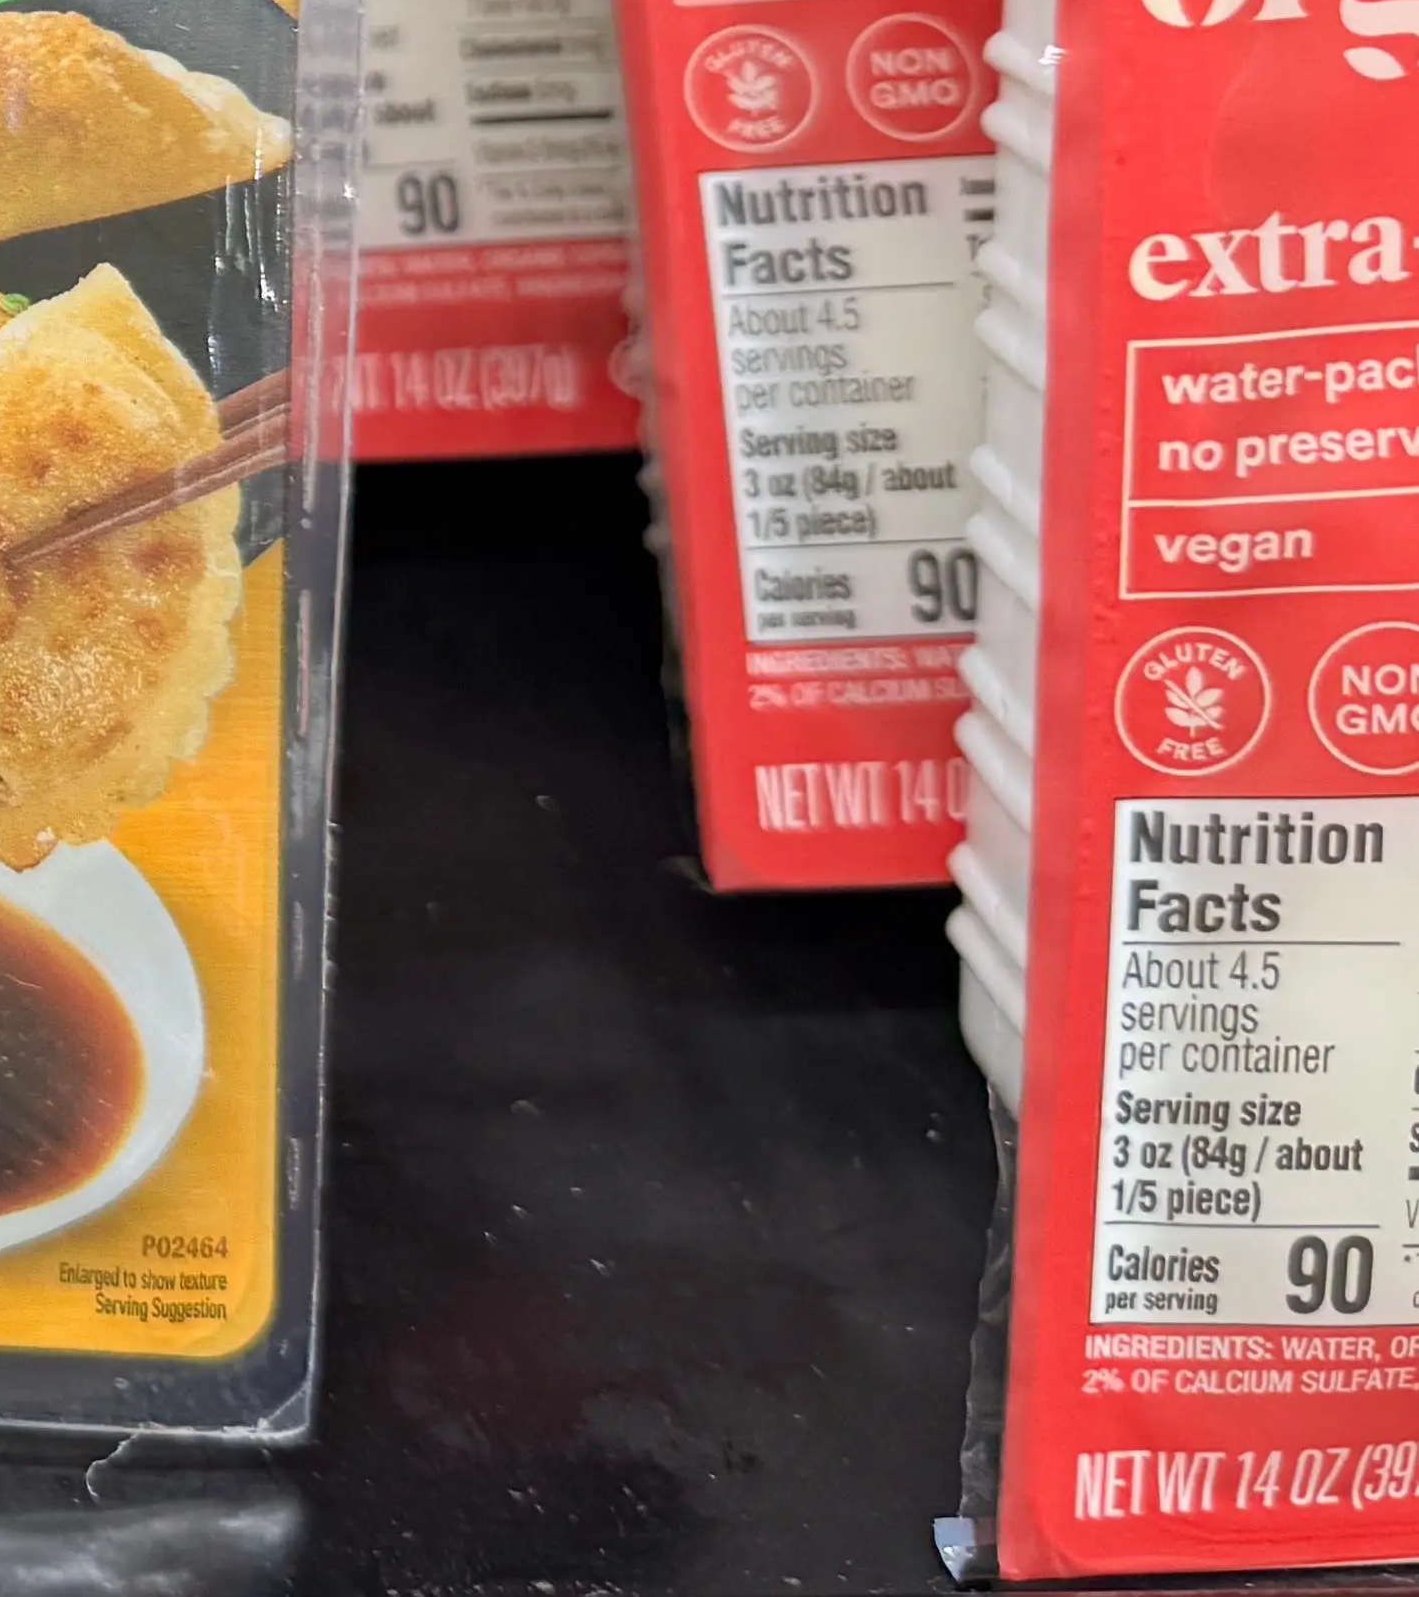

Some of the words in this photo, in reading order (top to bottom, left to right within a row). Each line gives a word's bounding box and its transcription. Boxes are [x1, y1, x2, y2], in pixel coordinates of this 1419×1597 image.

[869, 46, 952, 78] NON
[869, 79, 959, 110] GMO
[396, 172, 460, 236] 90
[714, 174, 930, 228] Nutrition
[722, 237, 854, 288] Facts
[729, 299, 809, 337] About
[1158, 436, 1223, 471] no
[881, 459, 959, 492] about
[1154, 527, 1314, 572] vegan
[908, 548, 979, 624] 90
[1143, 643, 1247, 683] GLUTEN
[1156, 735, 1225, 762] FREE
[754, 761, 821, 834] NET
[823, 759, 889, 831] WT
[1129, 810, 1384, 866] Nutrition
[1125, 878, 1282, 934] Facts
[1122, 950, 1219, 991] About
[1228, 950, 1282, 991] 4.5
[1120, 998, 1260, 1040] servings
[1118, 1042, 1171, 1077] per
[1182, 1037, 1336, 1075] container
[1115, 1090, 1230, 1130] Serving
[1240, 1095, 1302, 1128] size
[1113, 1139, 1132, 1170] 3
[1140, 1141, 1173, 1170] oz
[1181, 1134, 1248, 1177] (84g
[1274, 1138, 1365, 1173] about
[1111, 1180, 1159, 1216] 1/5
[1166, 1180, 1263, 1223] piece)
[60, 1261, 120, 1291] Enlarged
[141, 1268, 176, 1291] show
[179, 1270, 228, 1292] texture
[1107, 1243, 1221, 1284] Calories
[1285, 1233, 1376, 1317] 90
[95, 1292, 149, 1323] Serving
[151, 1296, 228, 1323] Suggestion
[1103, 1289, 1140, 1315] per
[1143, 1288, 1219, 1315] serving
[1084, 1333, 1276, 1361] INGREDIENTS:
[1281, 1334, 1383, 1364] WATER,
[1080, 1367, 1125, 1396] 2%
[1130, 1368, 1170, 1395] OF
[1174, 1368, 1295, 1396] CALCIUM
[1074, 1449, 1152, 1522] NET
[1156, 1450, 1227, 1516] WT
[1235, 1448, 1283, 1513] 14
[1288, 1445, 1351, 1508] OZ
[1350, 1438, 1419, 1511] (39
